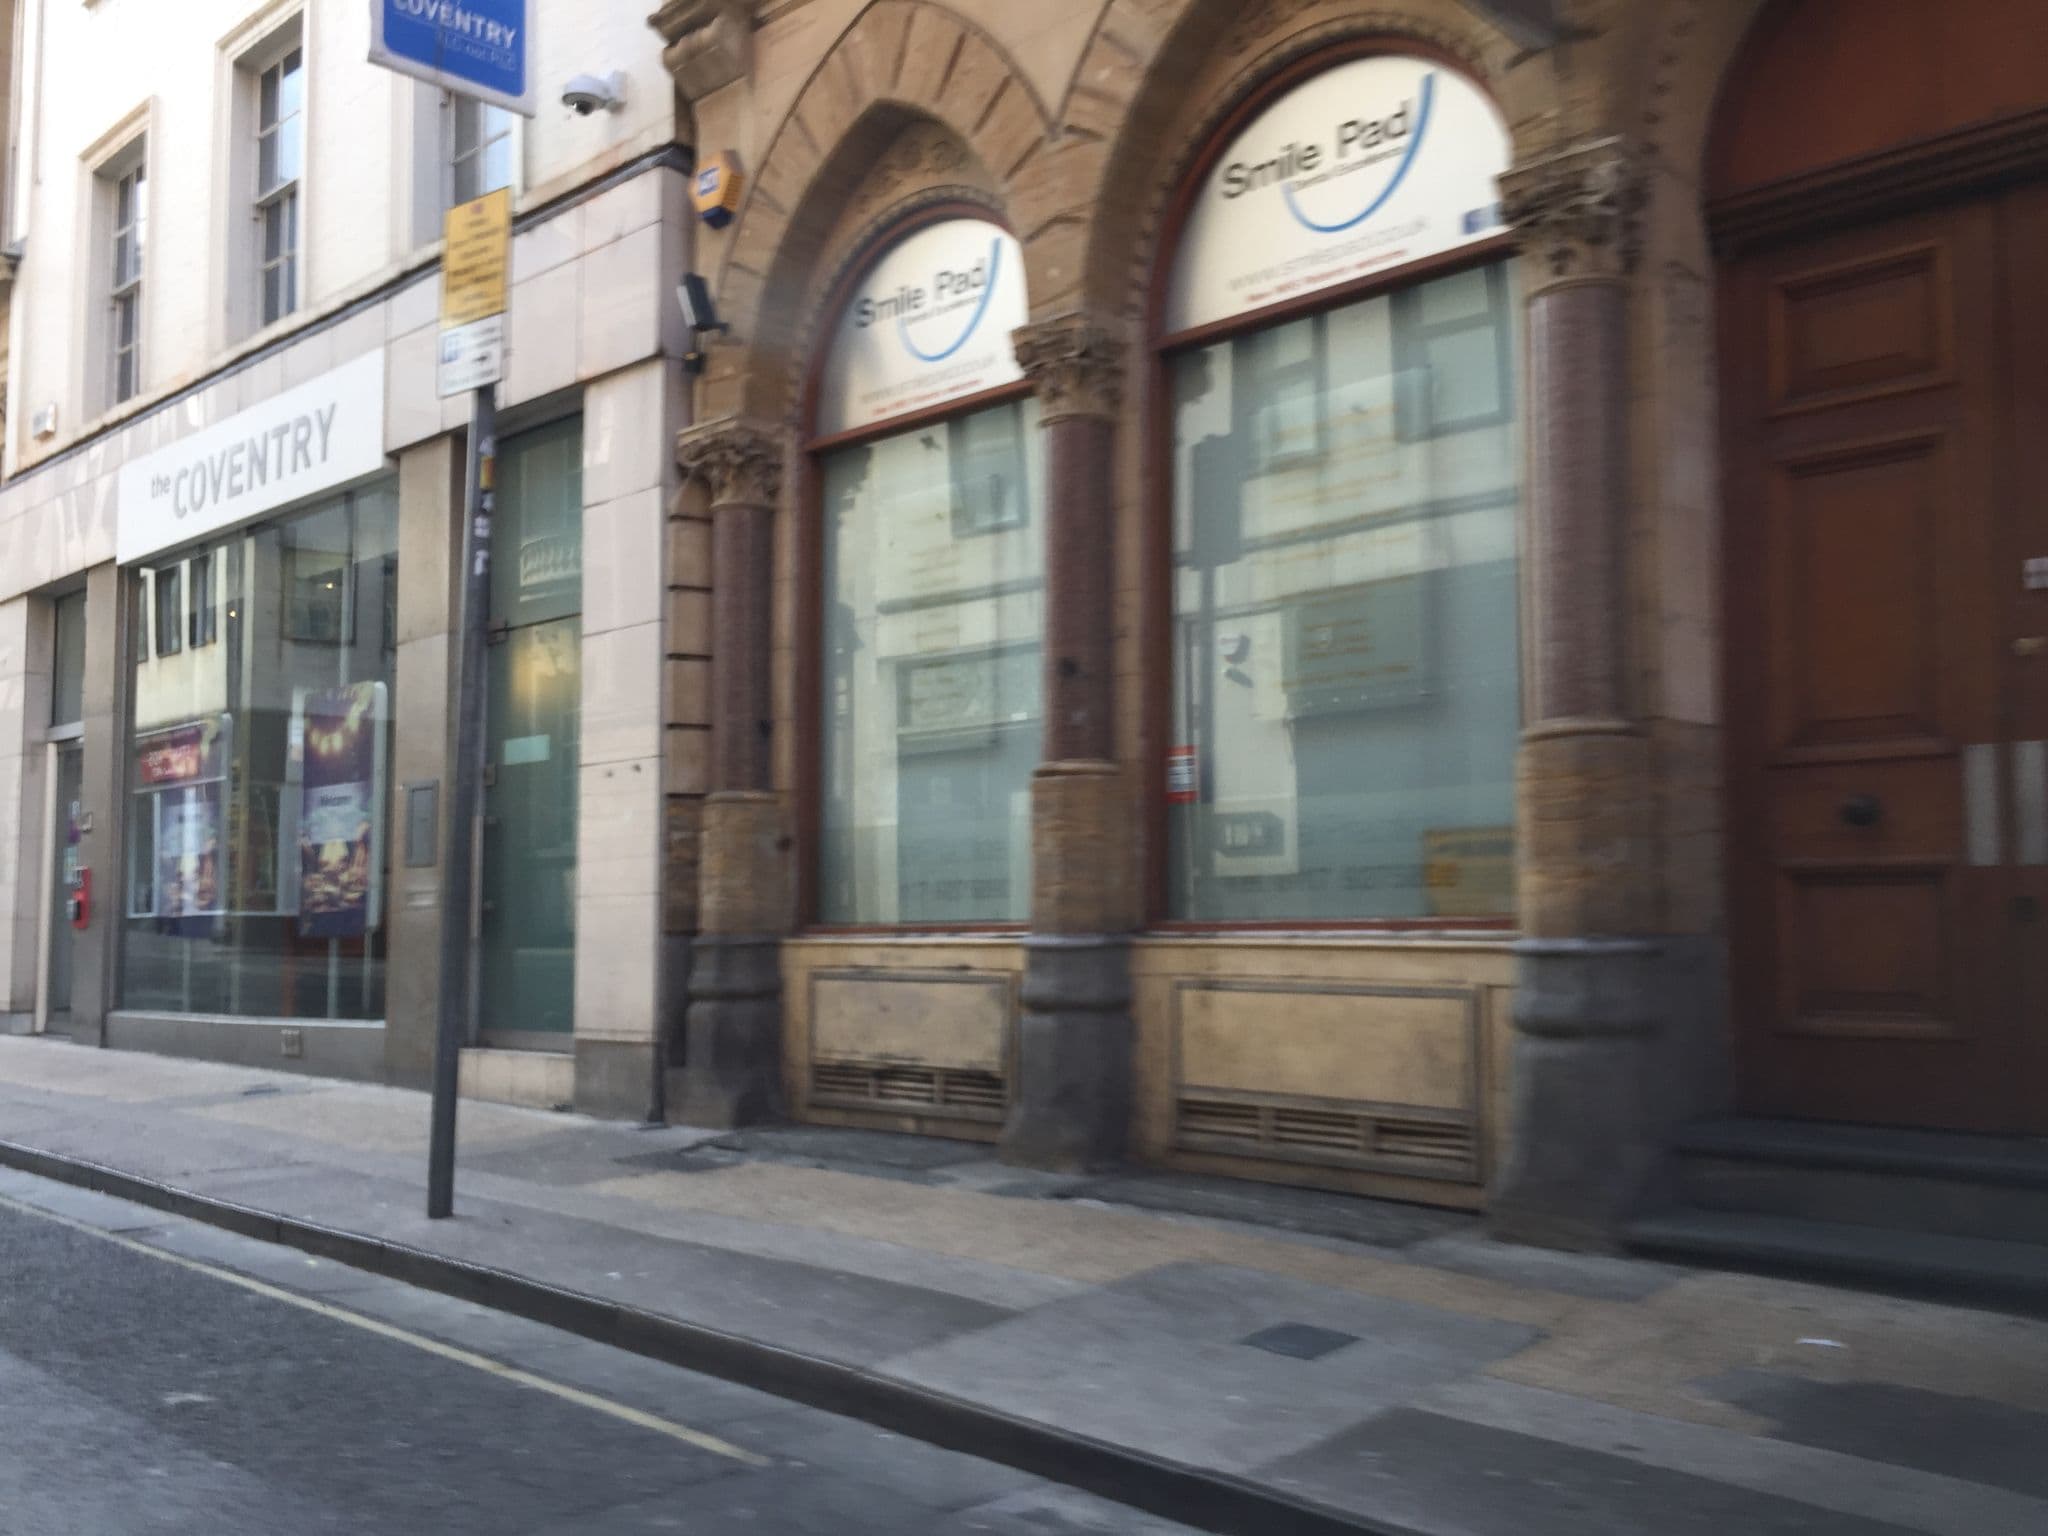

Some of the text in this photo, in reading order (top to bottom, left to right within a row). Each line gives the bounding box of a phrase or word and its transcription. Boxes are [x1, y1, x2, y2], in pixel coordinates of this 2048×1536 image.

[1222, 142, 1322, 199] Smile
[1337, 99, 1413, 158] Pad
[855, 285, 926, 329] Smile
[935, 256, 987, 300] Pad
[151, 402, 336, 520] the COVENTRY
